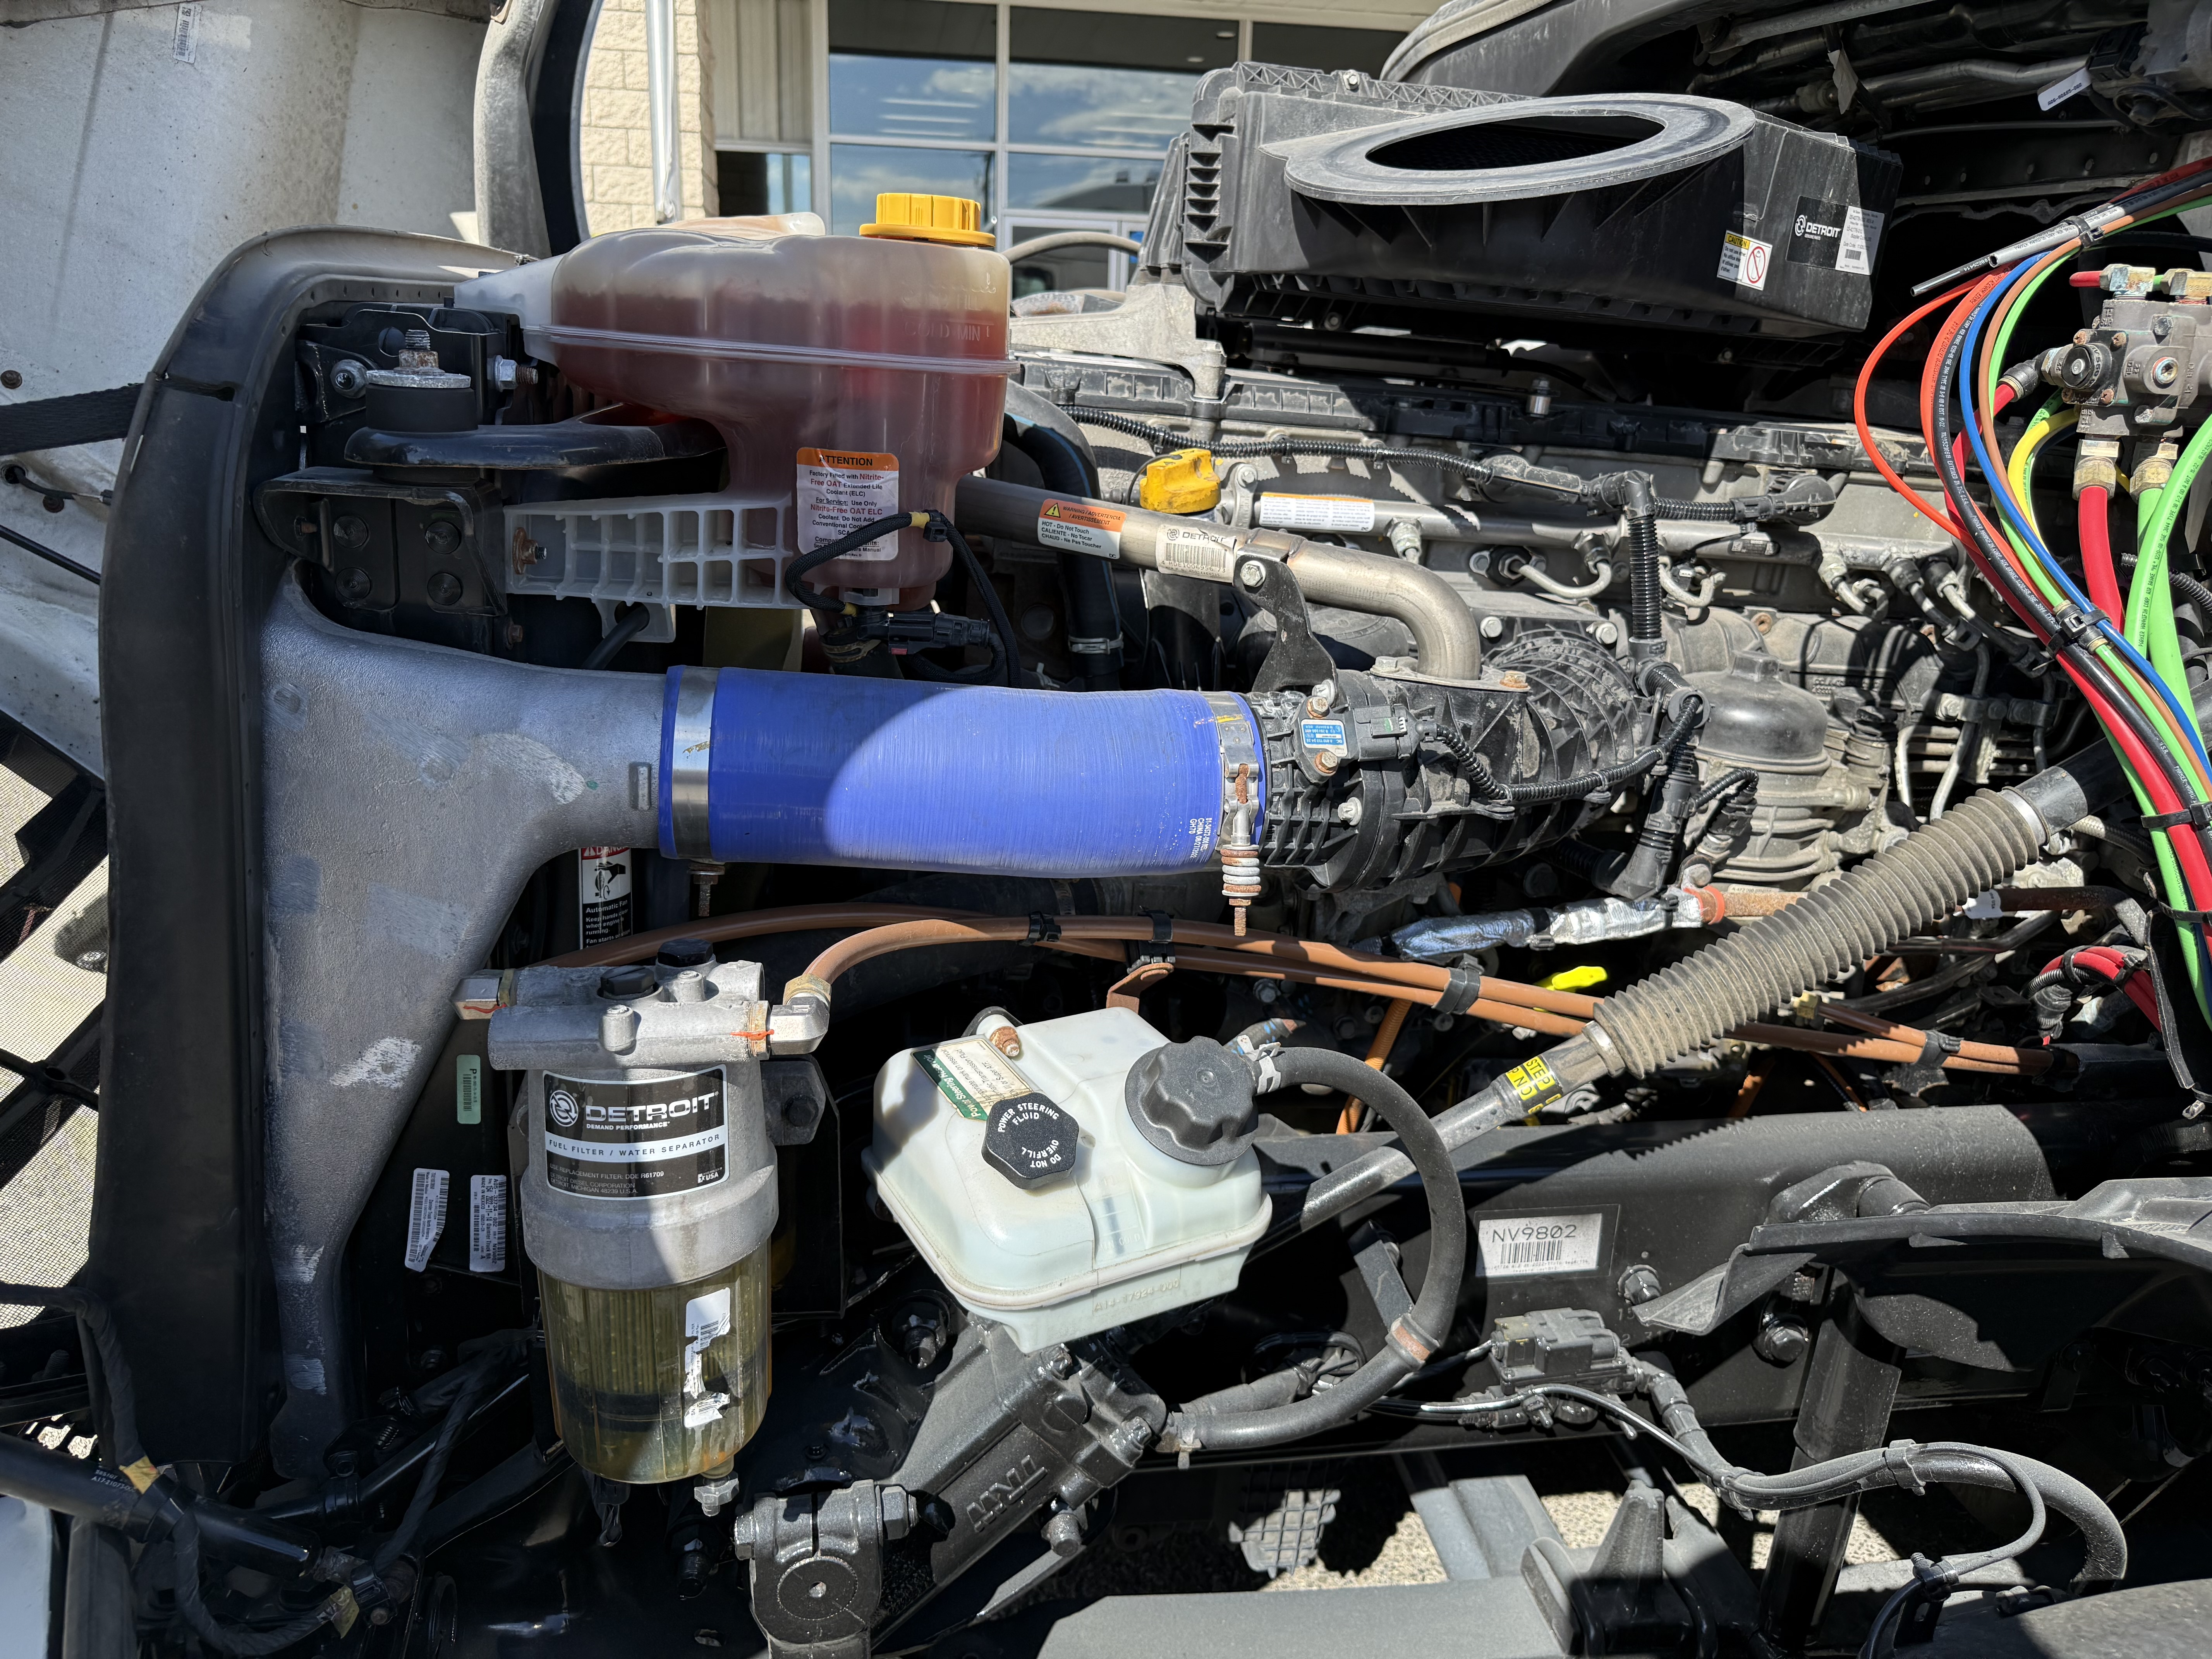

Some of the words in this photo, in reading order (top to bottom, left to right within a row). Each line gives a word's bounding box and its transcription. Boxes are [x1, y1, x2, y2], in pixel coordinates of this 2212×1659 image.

[1805, 222, 1841, 238] DETROIT
[1728, 236, 1747, 247] CAUTION
[2100, 317, 2113, 326] SUP
[958, 325, 980, 341] MIN
[819, 455, 872, 466] ATTENTION
[810, 471, 828, 479] Factory
[811, 504, 848, 514] Nitrite-Free
[1088, 512, 1120, 520] ADVERTENCIA
[1072, 514, 1110, 525] AVERTISSEMENT
[1042, 527, 1066, 536] CALIENTE
[1188, 819, 1197, 834] GH70
[1196, 818, 1204, 835] CHINA
[1190, 836, 1202, 858] 08/27/2022
[586, 903, 618, 913] Automatic
[941, 1049, 958, 1065] reservoir
[956, 1049, 965, 1059] Fluid
[924, 1054, 948, 1079] Reservoir
[959, 1068, 970, 1080] mark
[965, 1058, 985, 1083] Transmission
[1526, 1059, 1550, 1084] STEP
[991, 1069, 1004, 1080] Super
[945, 1075, 966, 1100] Steering
[585, 1092, 715, 1122] DETROIT
[962, 1099, 981, 1117] Power
[998, 1108, 1015, 1132] POWER
[1017, 1103, 1059, 1120] STEERING
[1012, 1112, 1039, 1125] FLUID
[616, 1121, 668, 1130] PERFORMANCE
[549, 1139, 567, 1151] FUEL
[572, 1147, 604, 1156] FILTER
[620, 1148, 655, 1156] WATER
[661, 1134, 720, 1153] SEPARATOR
[1021, 1139, 1059, 1158] OVERFILL
[1030, 1160, 1048, 1168] NOT
[1050, 1153, 1061, 1164] DO
[550, 1172, 569, 1182] DETROIT
[559, 1165, 599, 1178] REPLACEMENT
[551, 1178, 570, 1188] DETROIT,
[572, 1185, 599, 1193] MICHIGAN
[1492, 1224, 1577, 1243] NV9802
[1094, 1278, 1181, 1312] A14-17924-000
[967, 1455, 1048, 1533] TRW
